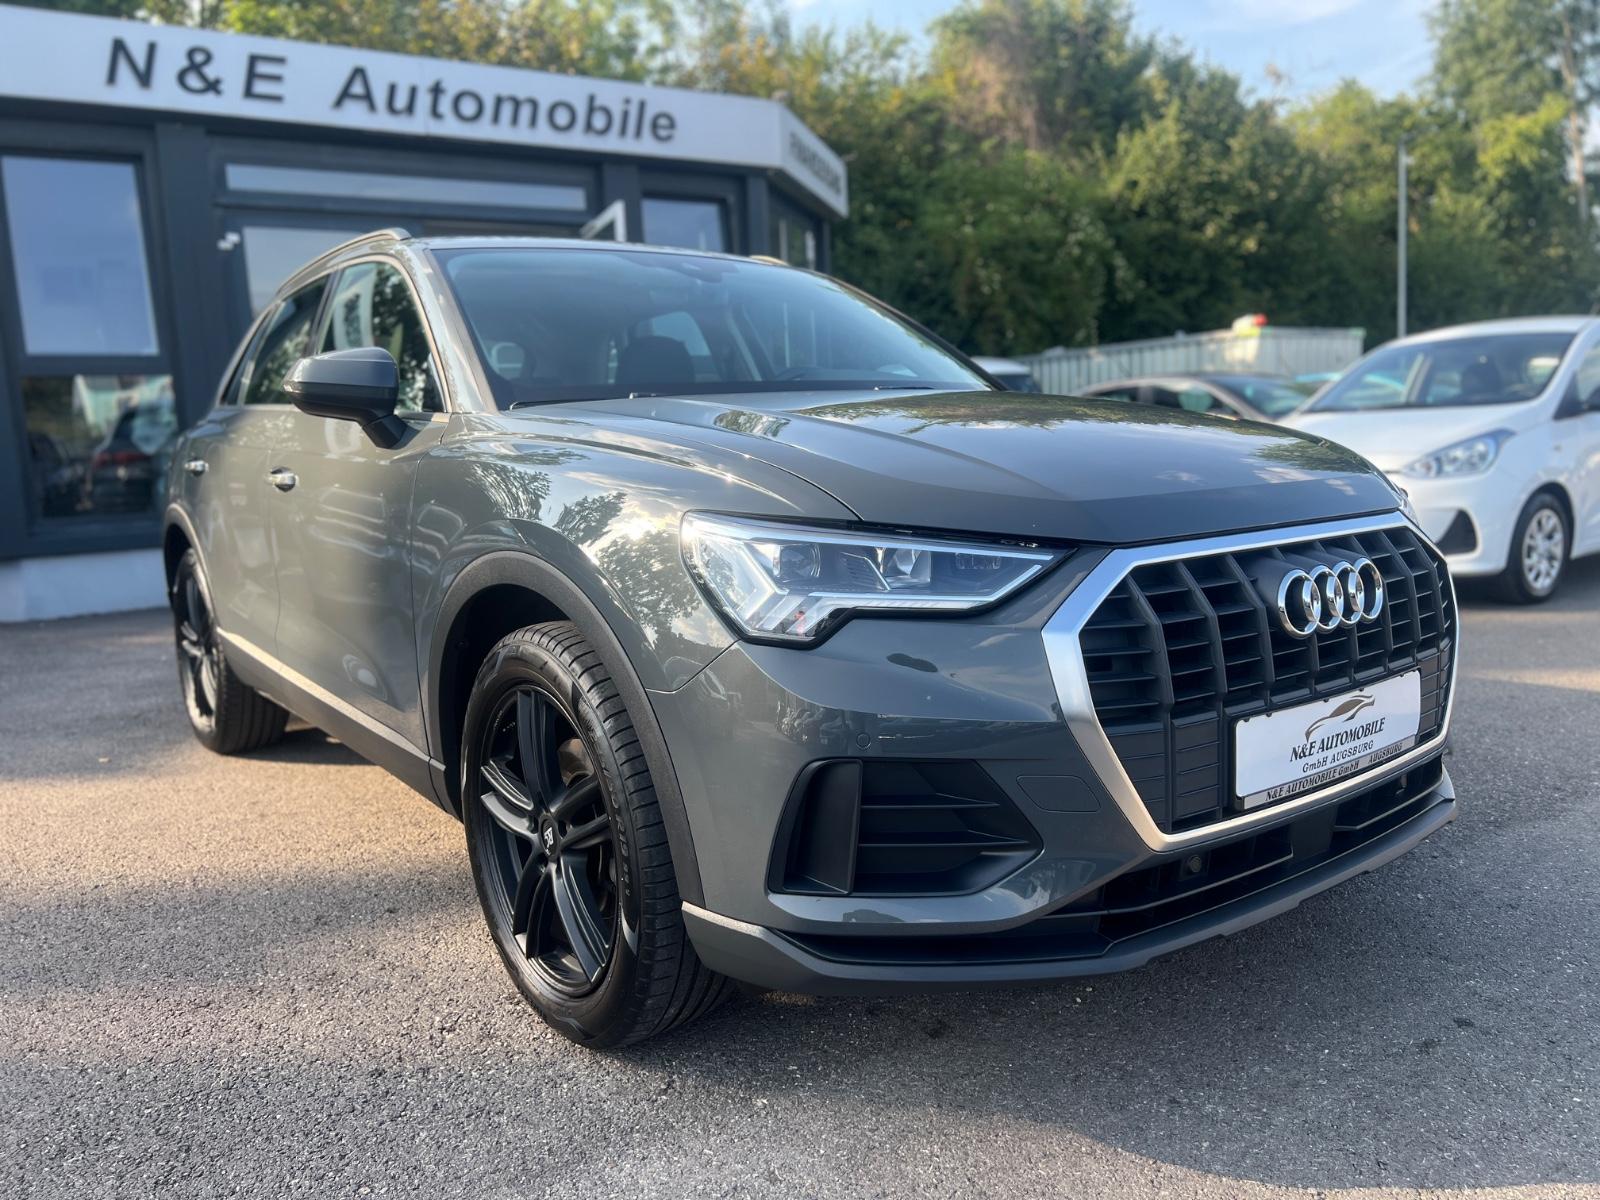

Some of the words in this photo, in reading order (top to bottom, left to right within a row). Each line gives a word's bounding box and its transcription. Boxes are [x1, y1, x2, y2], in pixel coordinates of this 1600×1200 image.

[332, 66, 677, 143] Automobile
[1290, 741, 1316, 762] N&E
[1317, 717, 1386, 754] AUTOMOBILE
[1302, 756, 1329, 773] GmbH
[1330, 740, 1374, 764] AUGSBURG
[1265, 786, 1286, 801] N&E
[1285, 768, 1338, 795] AUTOMOBILE
[1338, 759, 1360, 776] GmbH
[1368, 742, 1403, 764] AUGSBURG
